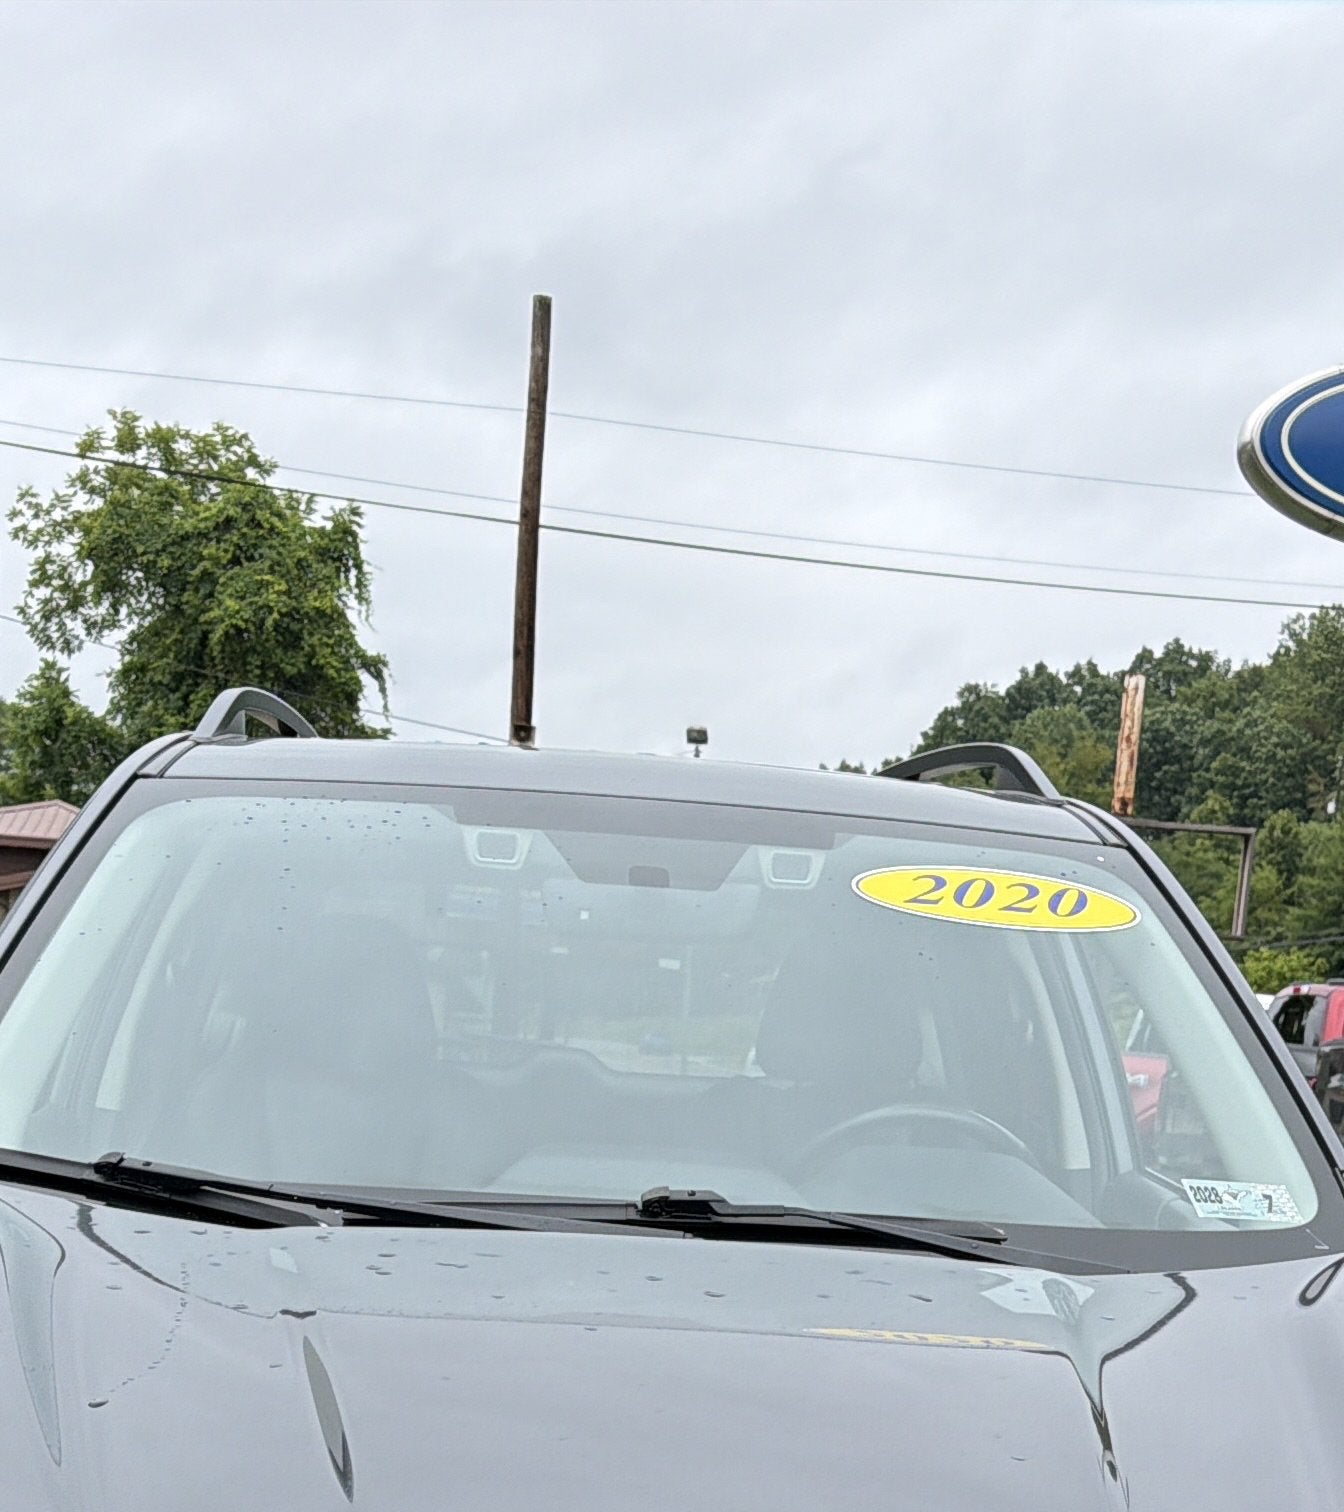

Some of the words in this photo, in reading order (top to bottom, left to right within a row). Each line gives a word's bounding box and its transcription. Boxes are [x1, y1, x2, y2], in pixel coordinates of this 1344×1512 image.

[903, 874, 1089, 917] 2020
[1189, 1185, 1224, 1205] 2028
[1262, 1193, 1273, 1213] 7
